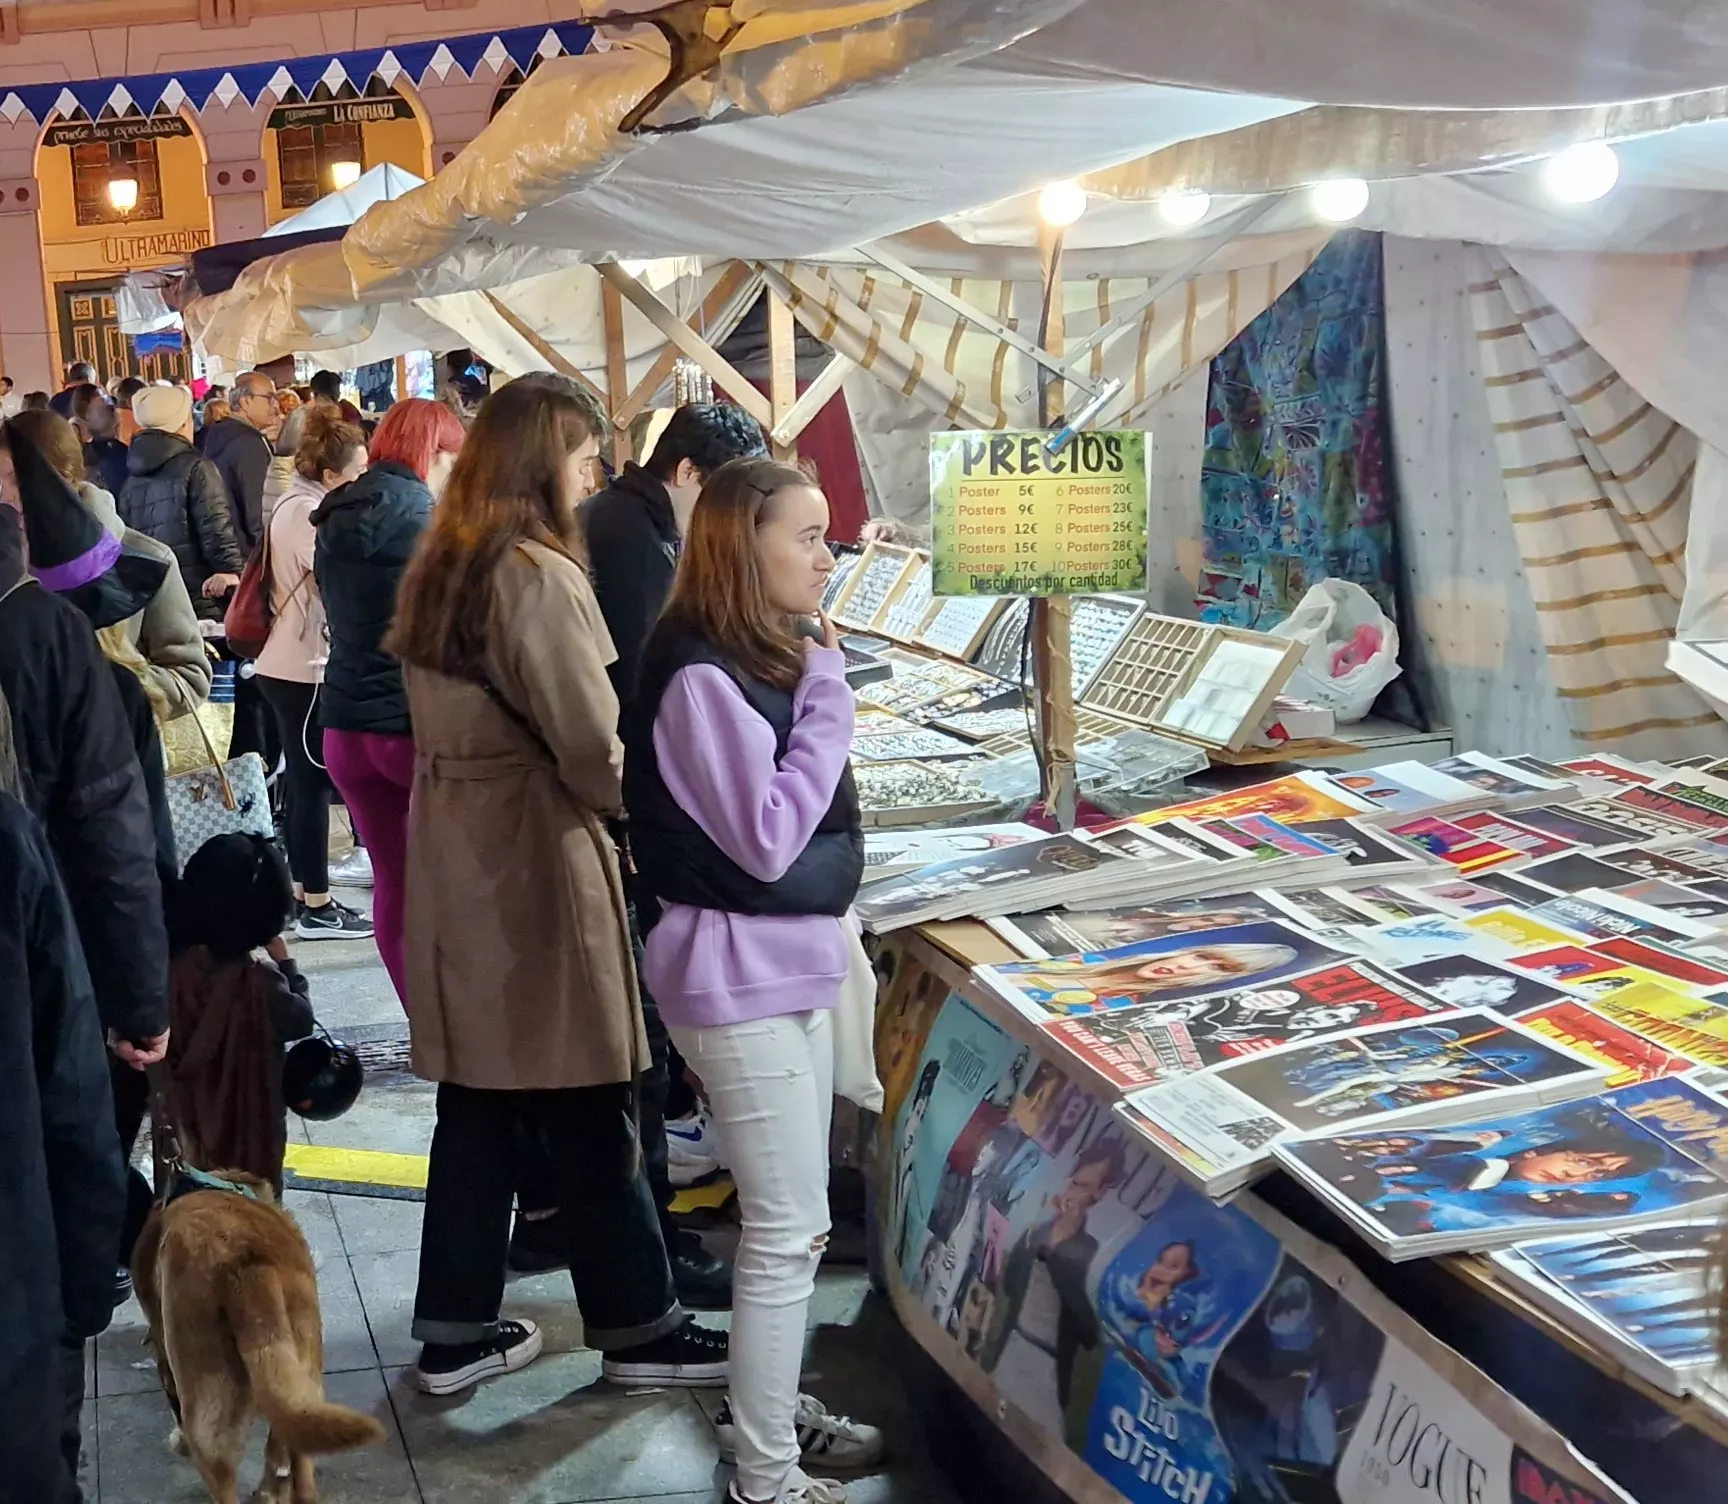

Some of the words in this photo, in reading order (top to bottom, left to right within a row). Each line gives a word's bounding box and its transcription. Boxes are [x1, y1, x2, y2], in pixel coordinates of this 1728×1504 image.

[347, 103, 396, 121] CONFIANZA
[962, 436, 1124, 476] PRECIOS
[948, 487, 954, 497] 1
[959, 487, 1000, 498] Poster
[1018, 485, 1035, 496] 5€
[1056, 486, 1064, 496] 6
[1068, 484, 1111, 496] Posters
[1112, 483, 1132, 495] 20€
[947, 506, 954, 517] 2
[958, 505, 1006, 516] Posters
[1018, 504, 1035, 516] 9€
[1055, 505, 1063, 515] 7
[1068, 503, 1111, 514] Posters
[1112, 502, 1133, 514] 23€
[947, 525, 955, 536] 3
[958, 524, 1006, 535] Posters
[1014, 523, 1038, 534] 12€
[1054, 523, 1063, 534] 8
[1067, 522, 1110, 534] Posters
[1112, 521, 1133, 532] 25€
[947, 543, 954, 554] 4
[958, 542, 1006, 554] Posters
[1014, 542, 1038, 554] 15€
[1054, 542, 1062, 553] 9
[1066, 541, 1110, 552] Posters
[1112, 540, 1133, 552] 28€
[946, 562, 954, 573] 5
[958, 562, 1005, 574] Posters
[1014, 560, 1037, 573] 17€
[1051, 560, 1066, 572] 10
[1066, 560, 1110, 572] Posters
[1112, 558, 1132, 570] 30€
[970, 574, 1041, 590] Descuentos
[1045, 575, 1065, 593] por
[1069, 571, 1118, 589] cantidad
[1373, 1381, 1488, 1504] VOGUE
